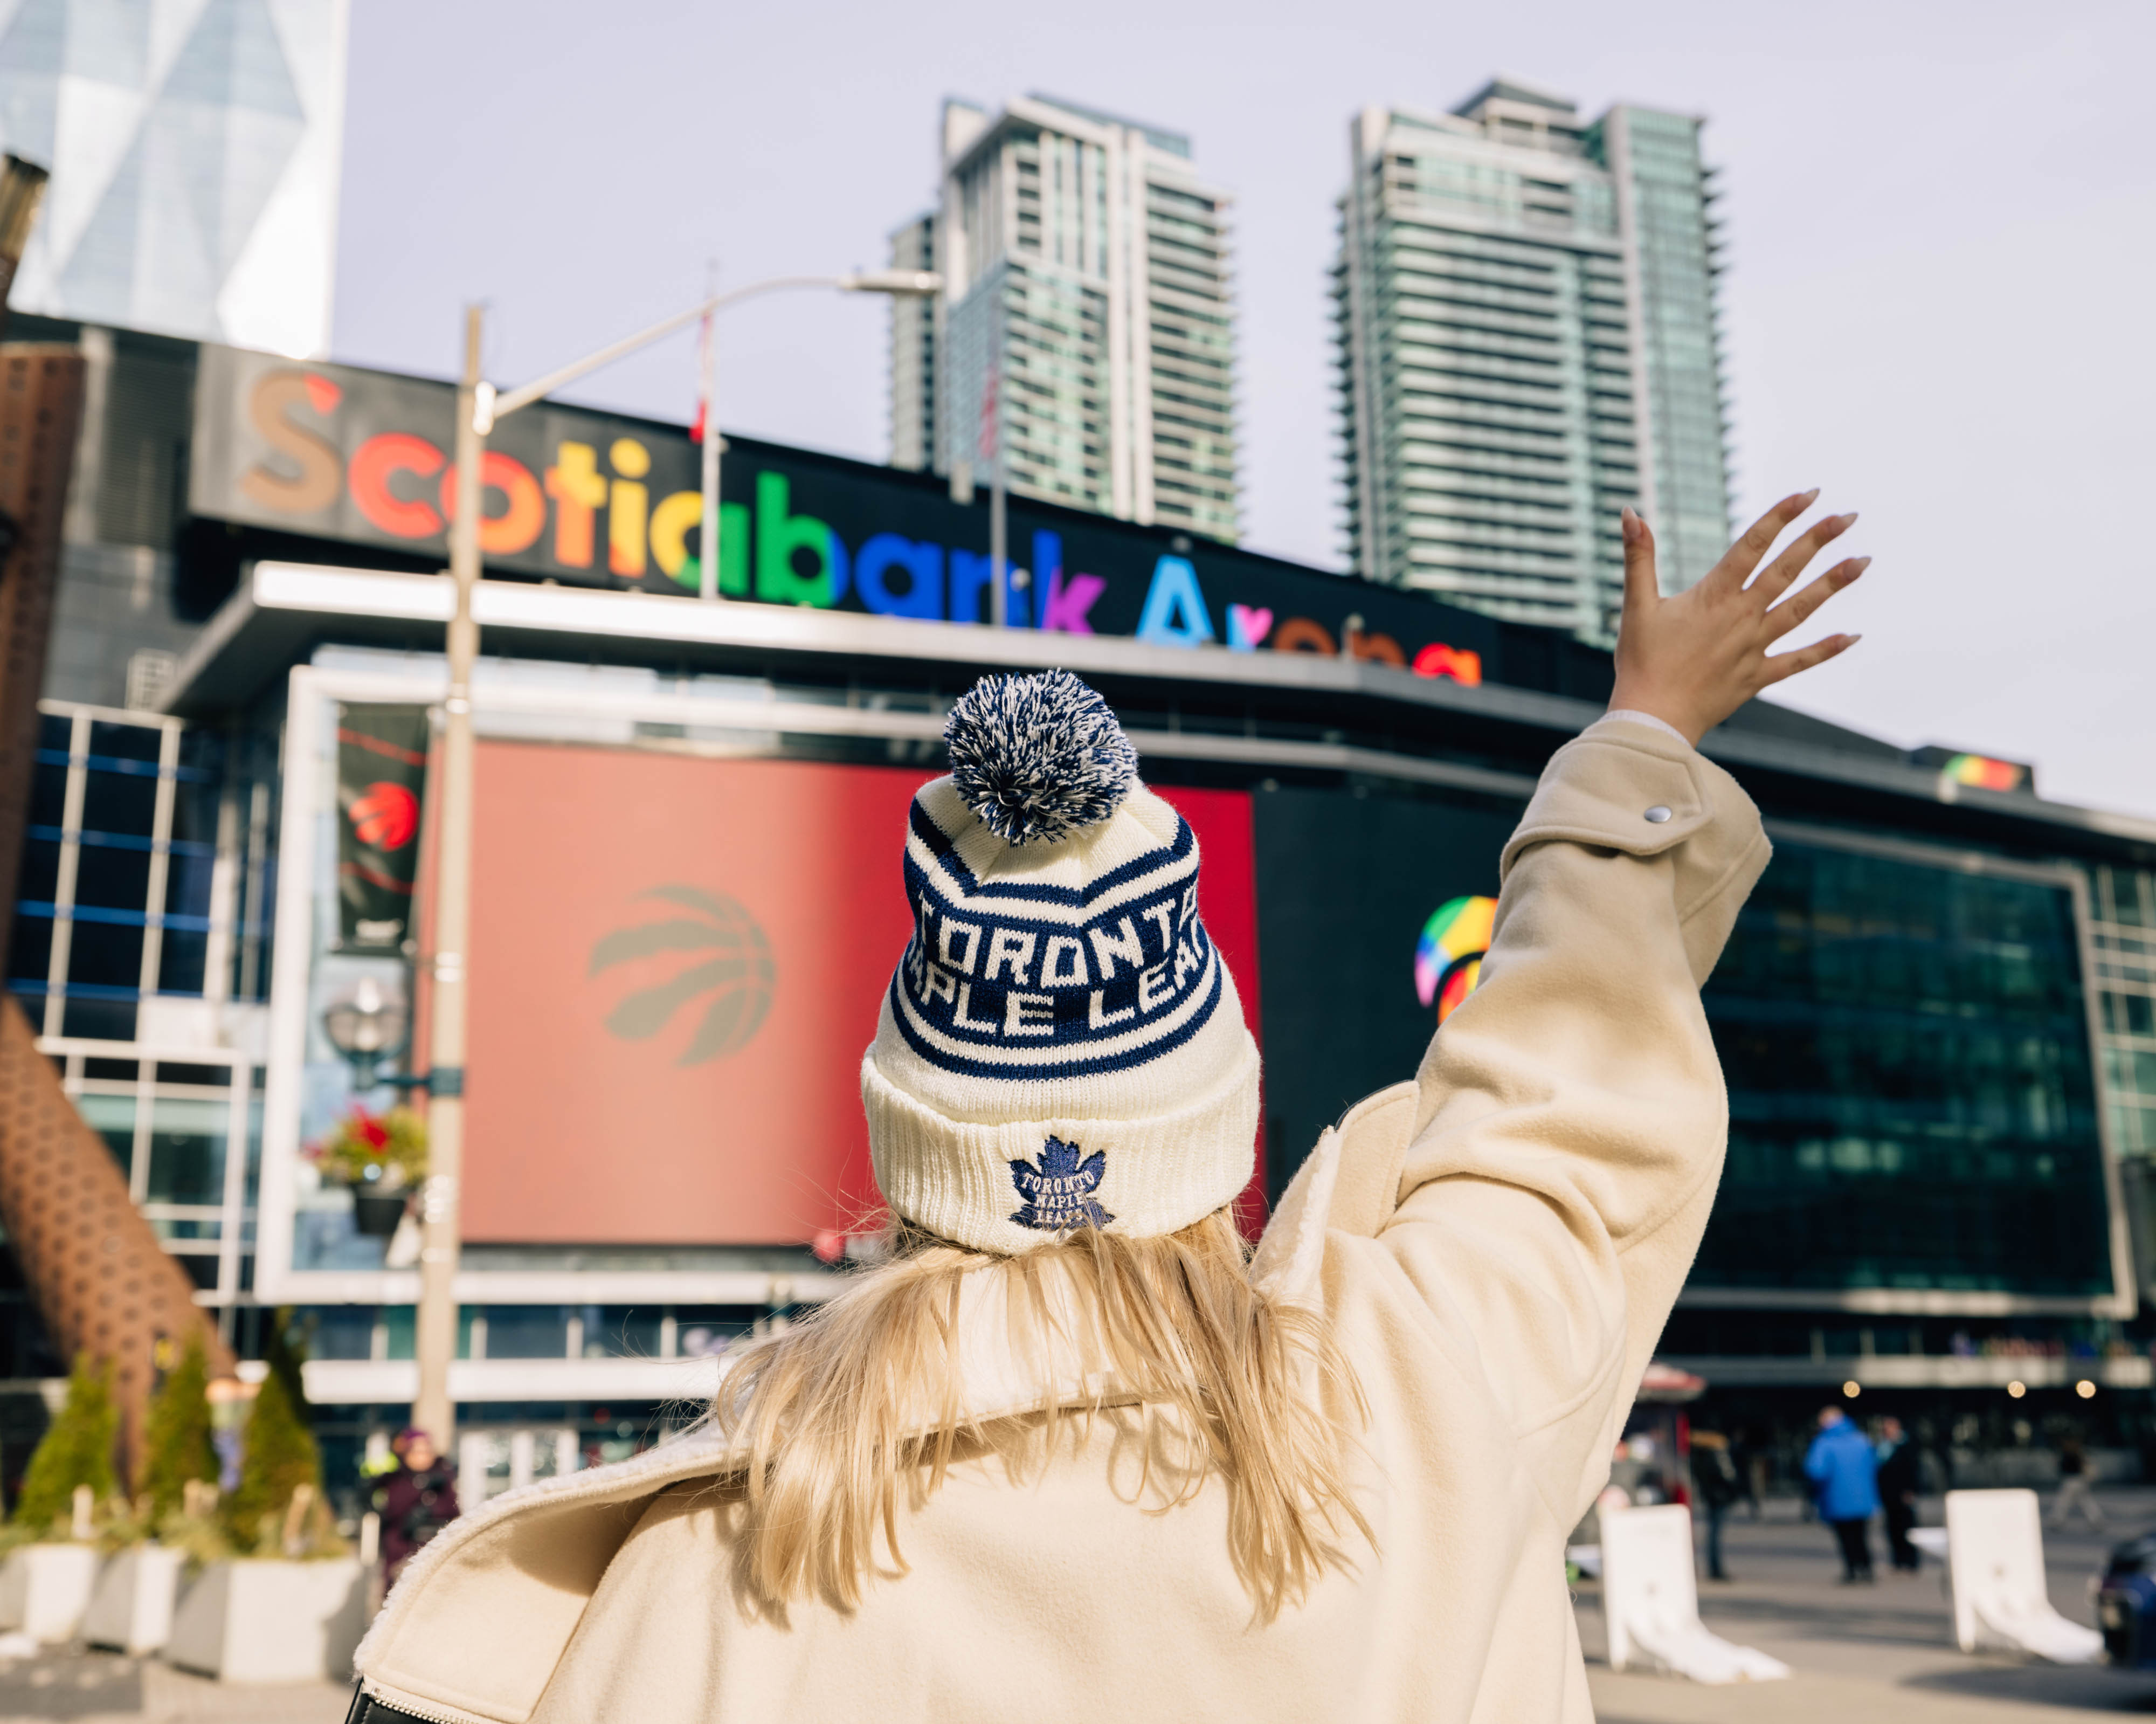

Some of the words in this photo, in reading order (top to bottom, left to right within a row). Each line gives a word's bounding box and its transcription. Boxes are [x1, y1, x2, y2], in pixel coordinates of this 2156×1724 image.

[240, 367, 1108, 638] Scotiabank
[1021, 1170, 1095, 1194] TORONTO
[1034, 1191, 1085, 1209] MAPLE
